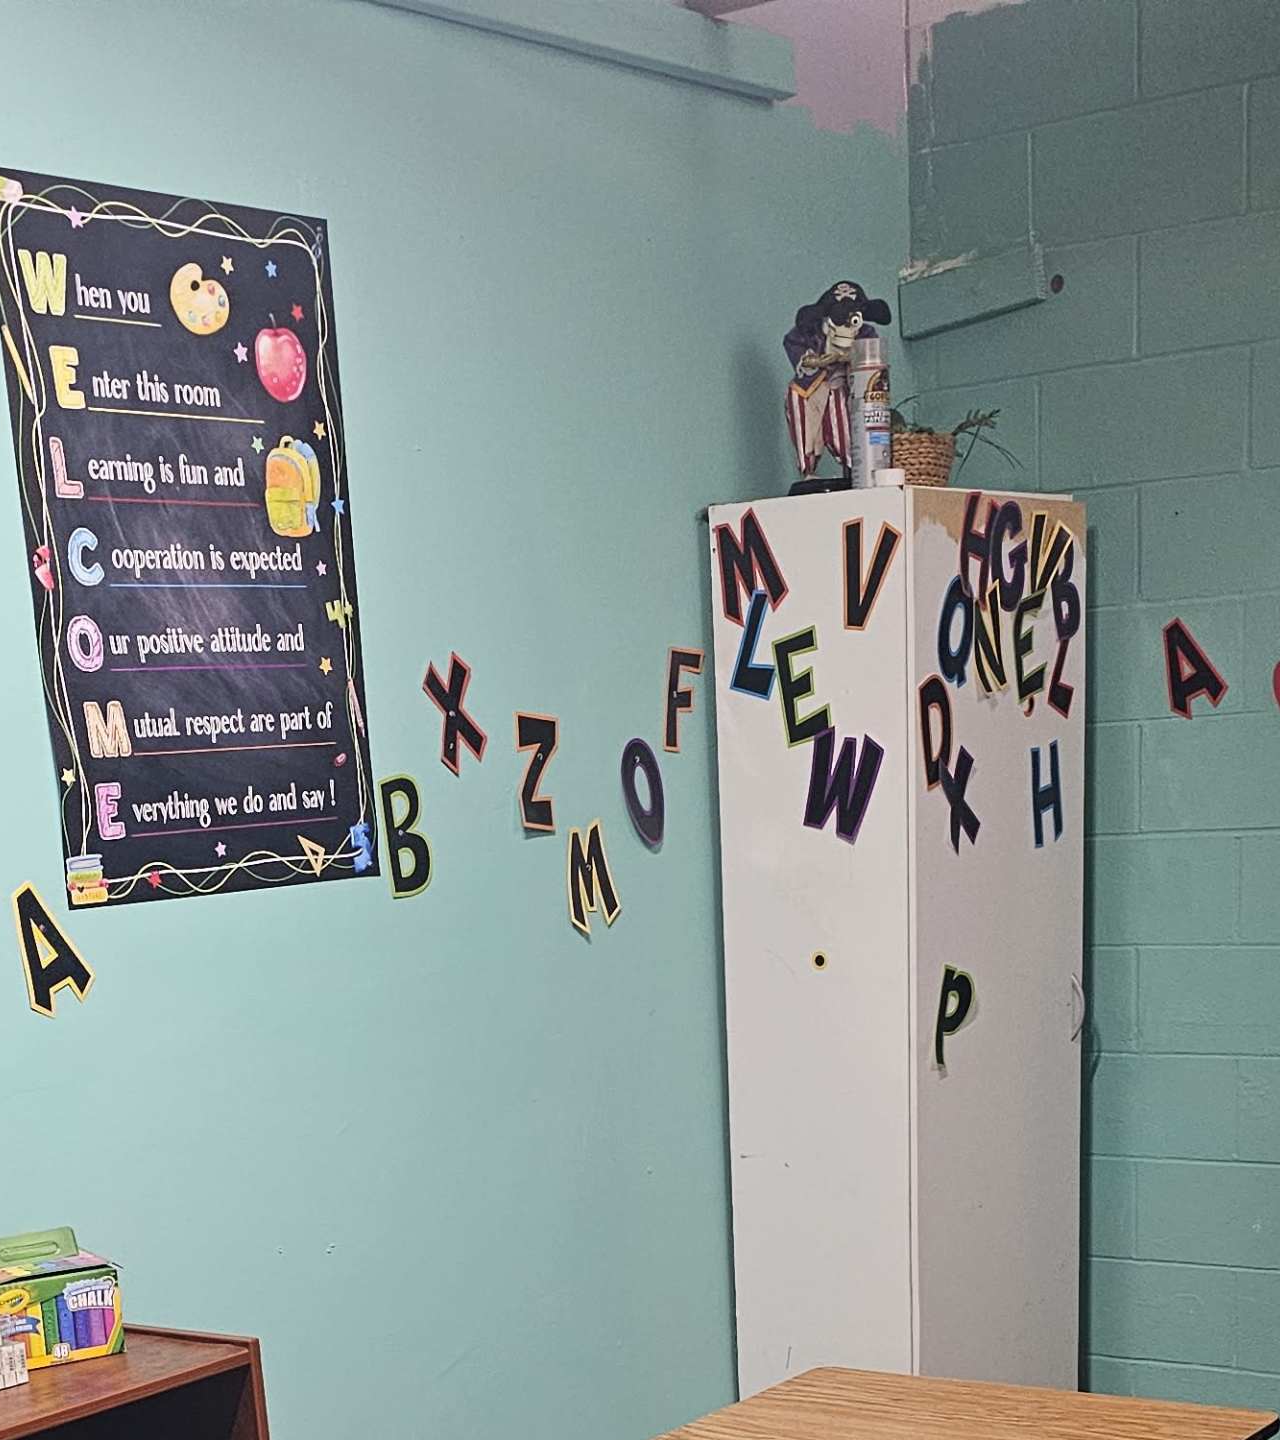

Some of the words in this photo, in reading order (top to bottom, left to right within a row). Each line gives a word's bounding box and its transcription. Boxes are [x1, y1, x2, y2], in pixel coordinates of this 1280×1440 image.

[117, 290, 151, 316] you
[136, 371, 169, 404] this
[175, 383, 222, 408] room
[160, 455, 174, 485] is
[179, 455, 208, 486] fun
[214, 458, 246, 487] and
[210, 546, 225, 570] is
[230, 543, 303, 579] expected
[714, 507, 789, 627] M
[842, 517, 902, 631] V
[136, 628, 205, 663] positive
[210, 625, 272, 655] attitude
[277, 624, 305, 653] and
[730, 589, 776, 700] L
[772, 625, 832, 748] E
[1015, 587, 1048, 705] E
[1162, 617, 1229, 720] A
[185, 710, 245, 743] respect
[250, 712, 274, 734] are
[280, 708, 312, 739] part
[317, 701, 333, 729] of
[422, 651, 488, 777] X
[663, 647, 705, 753] F
[214, 797, 238, 817] we
[243, 788, 263, 813] do
[268, 786, 297, 812] and
[514, 711, 559, 832] Z
[803, 726, 884, 845] W
[1030, 738, 1064, 848] H
[377, 773, 433, 899] B
[567, 817, 622, 935] M
[12, 880, 96, 1018] A
[934, 963, 977, 1068] P
[69, 1287, 115, 1310] CHALK
